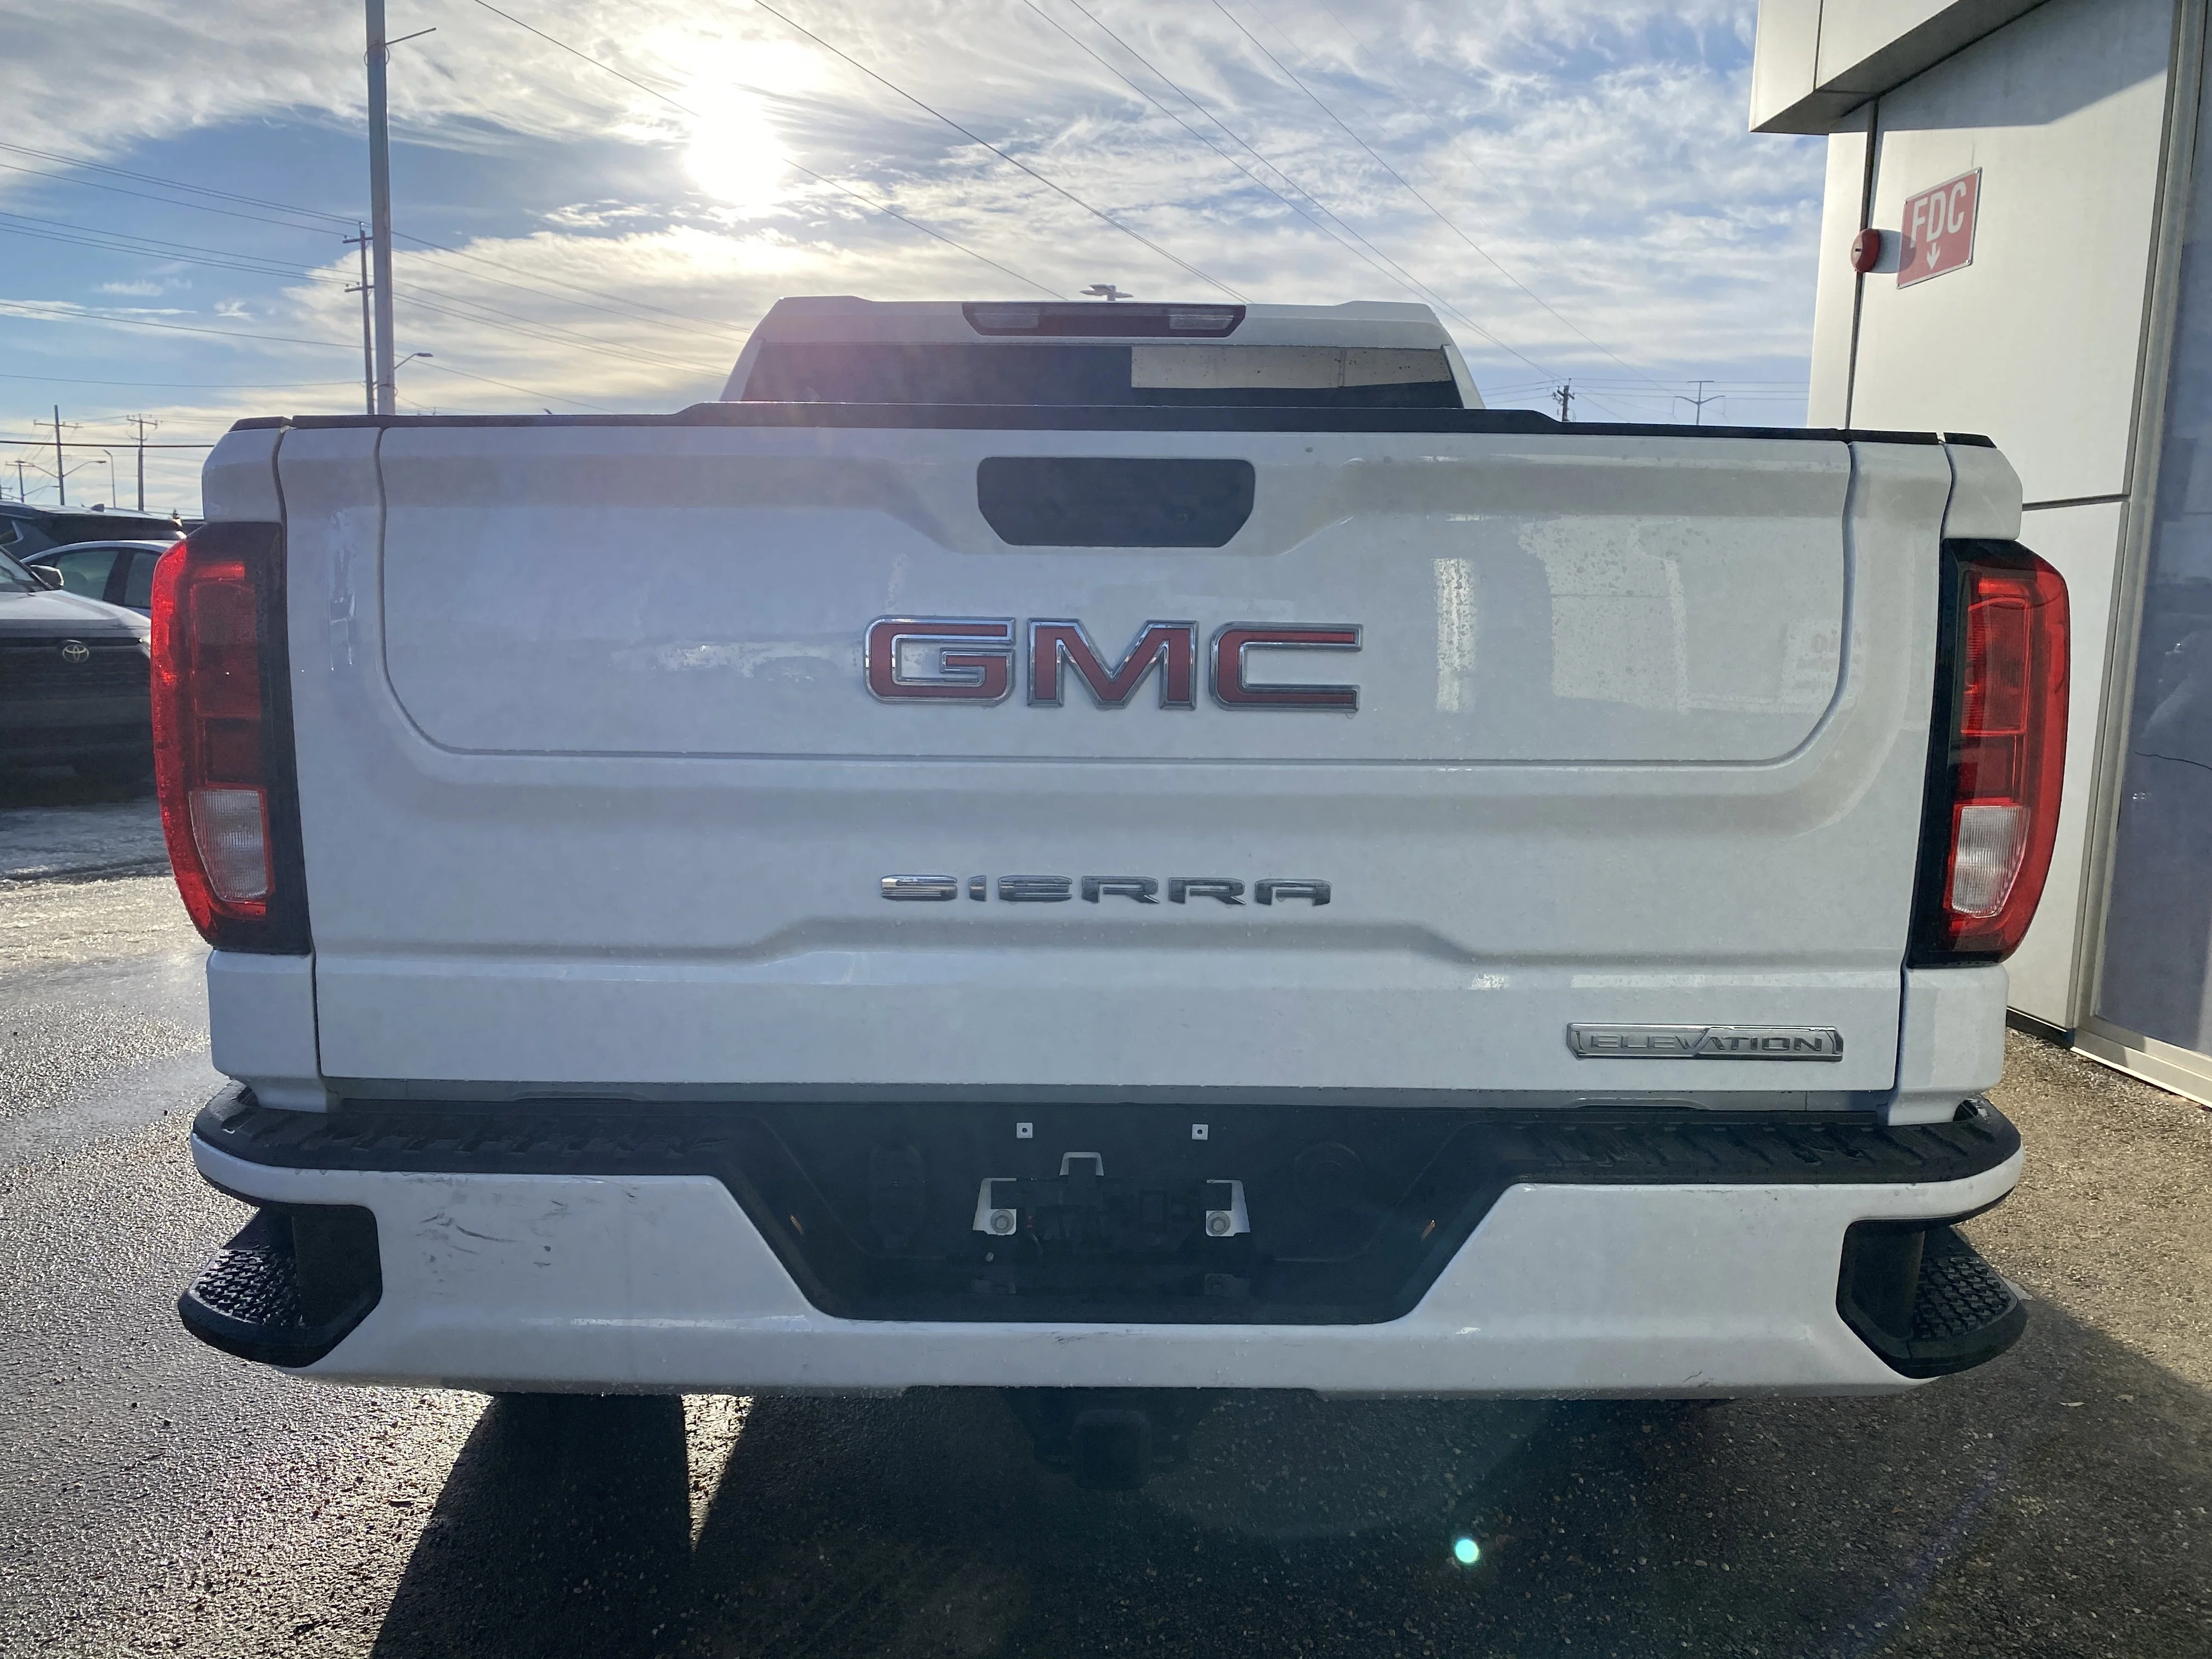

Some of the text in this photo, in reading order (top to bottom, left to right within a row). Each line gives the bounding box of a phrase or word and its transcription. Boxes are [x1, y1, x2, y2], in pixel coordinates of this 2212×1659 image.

[1910, 182, 1966, 249] FDC
[865, 615, 1364, 712] GMC
[881, 874, 1332, 905] SIERRA
[1591, 1034, 1823, 1053] ELEVATION
